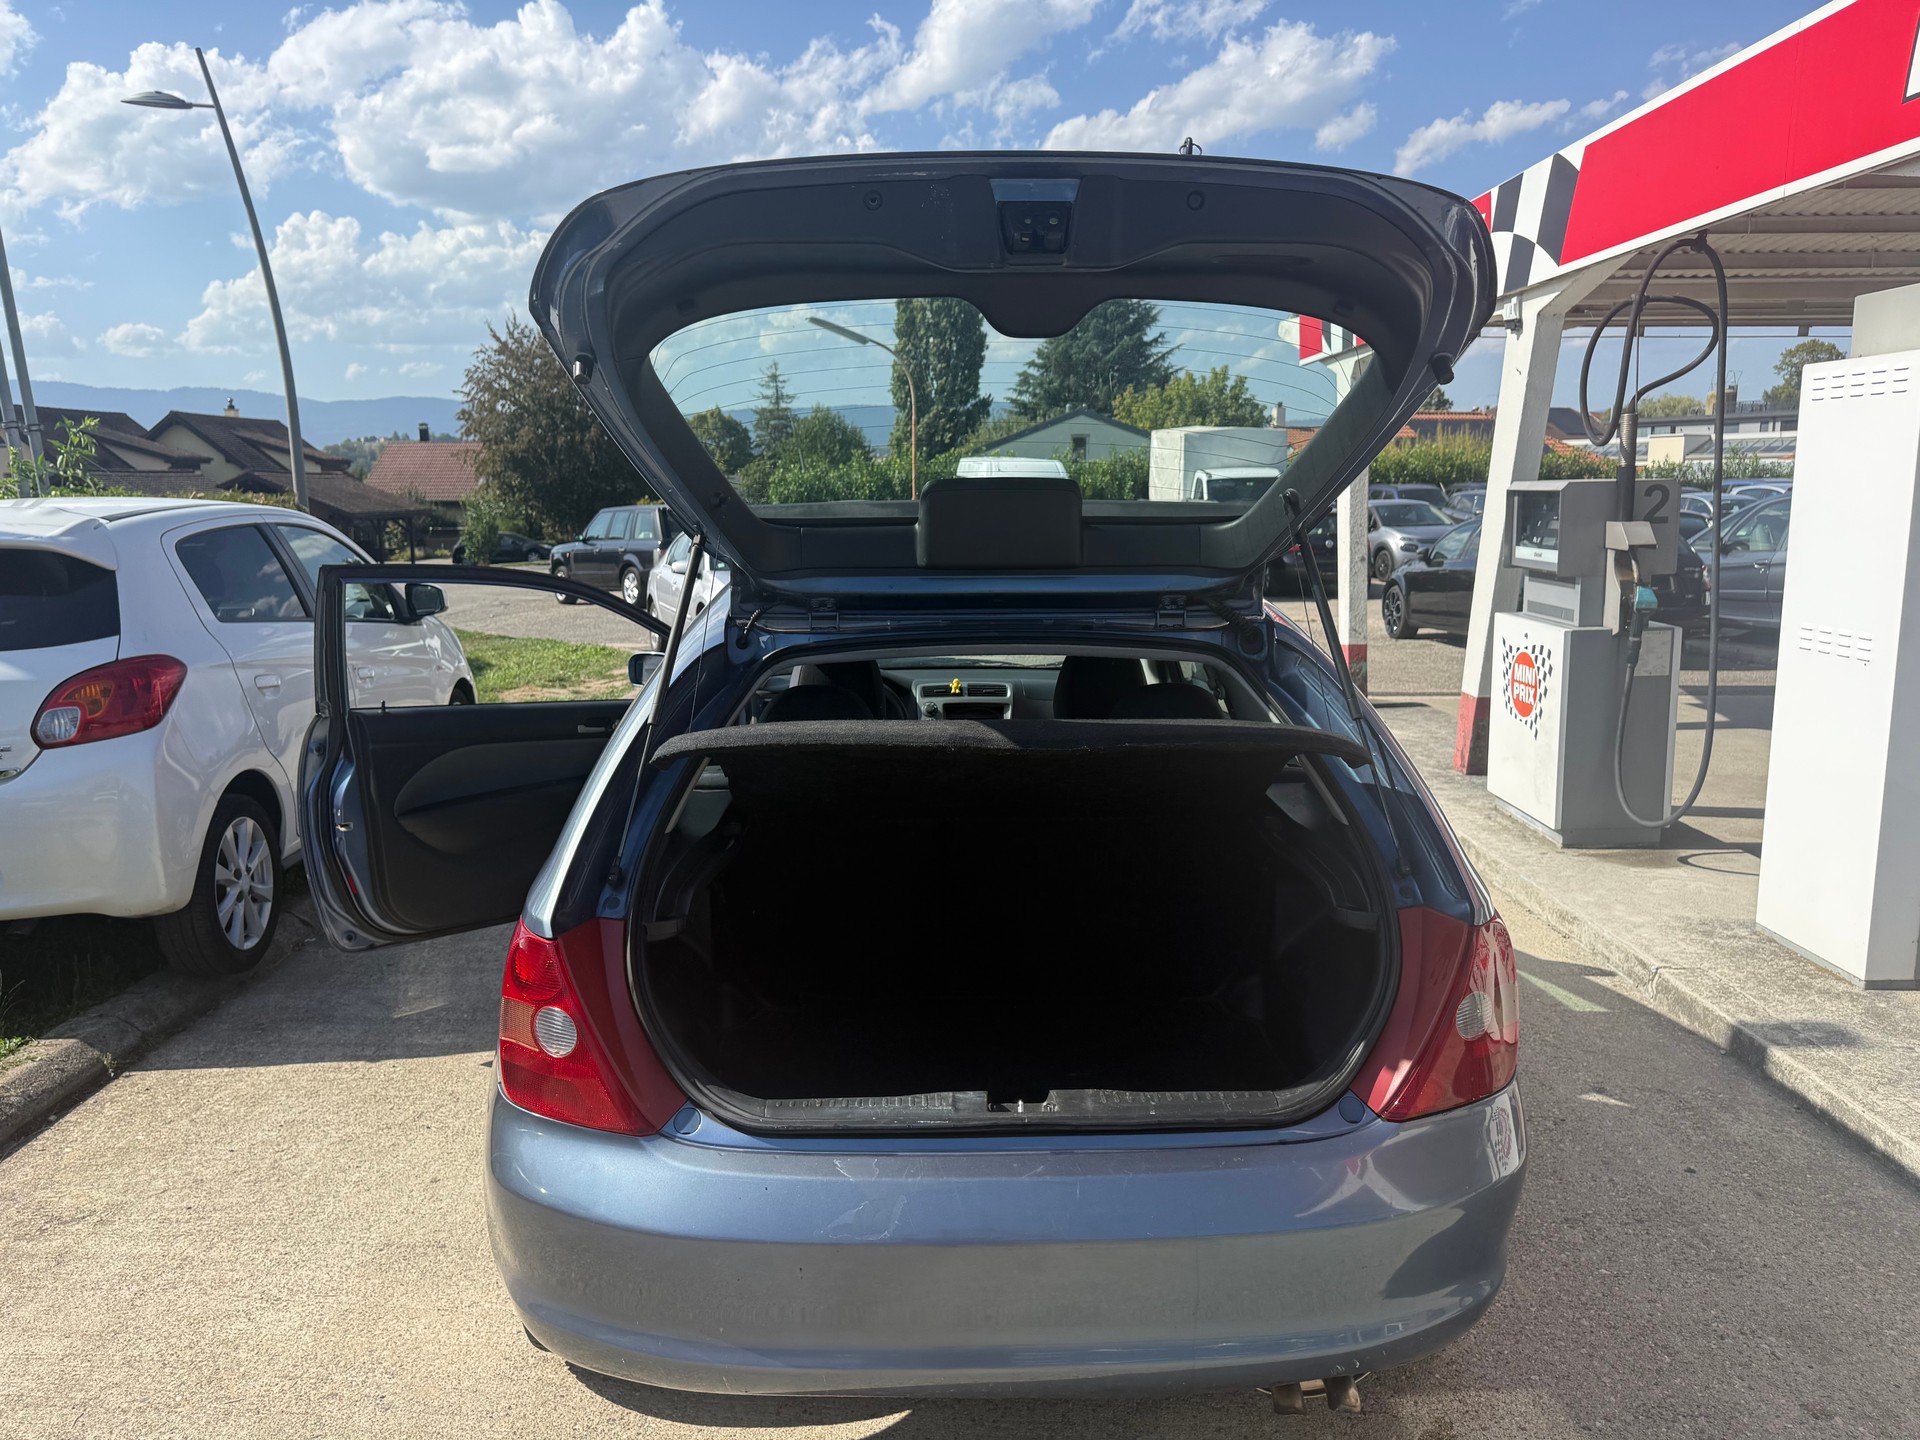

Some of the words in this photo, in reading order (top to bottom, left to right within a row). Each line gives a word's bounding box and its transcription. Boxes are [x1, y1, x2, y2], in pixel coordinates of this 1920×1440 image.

[1643, 484, 1670, 523] 2
[1514, 662, 1536, 686] MINI
[1513, 681, 1536, 706] PRIX
